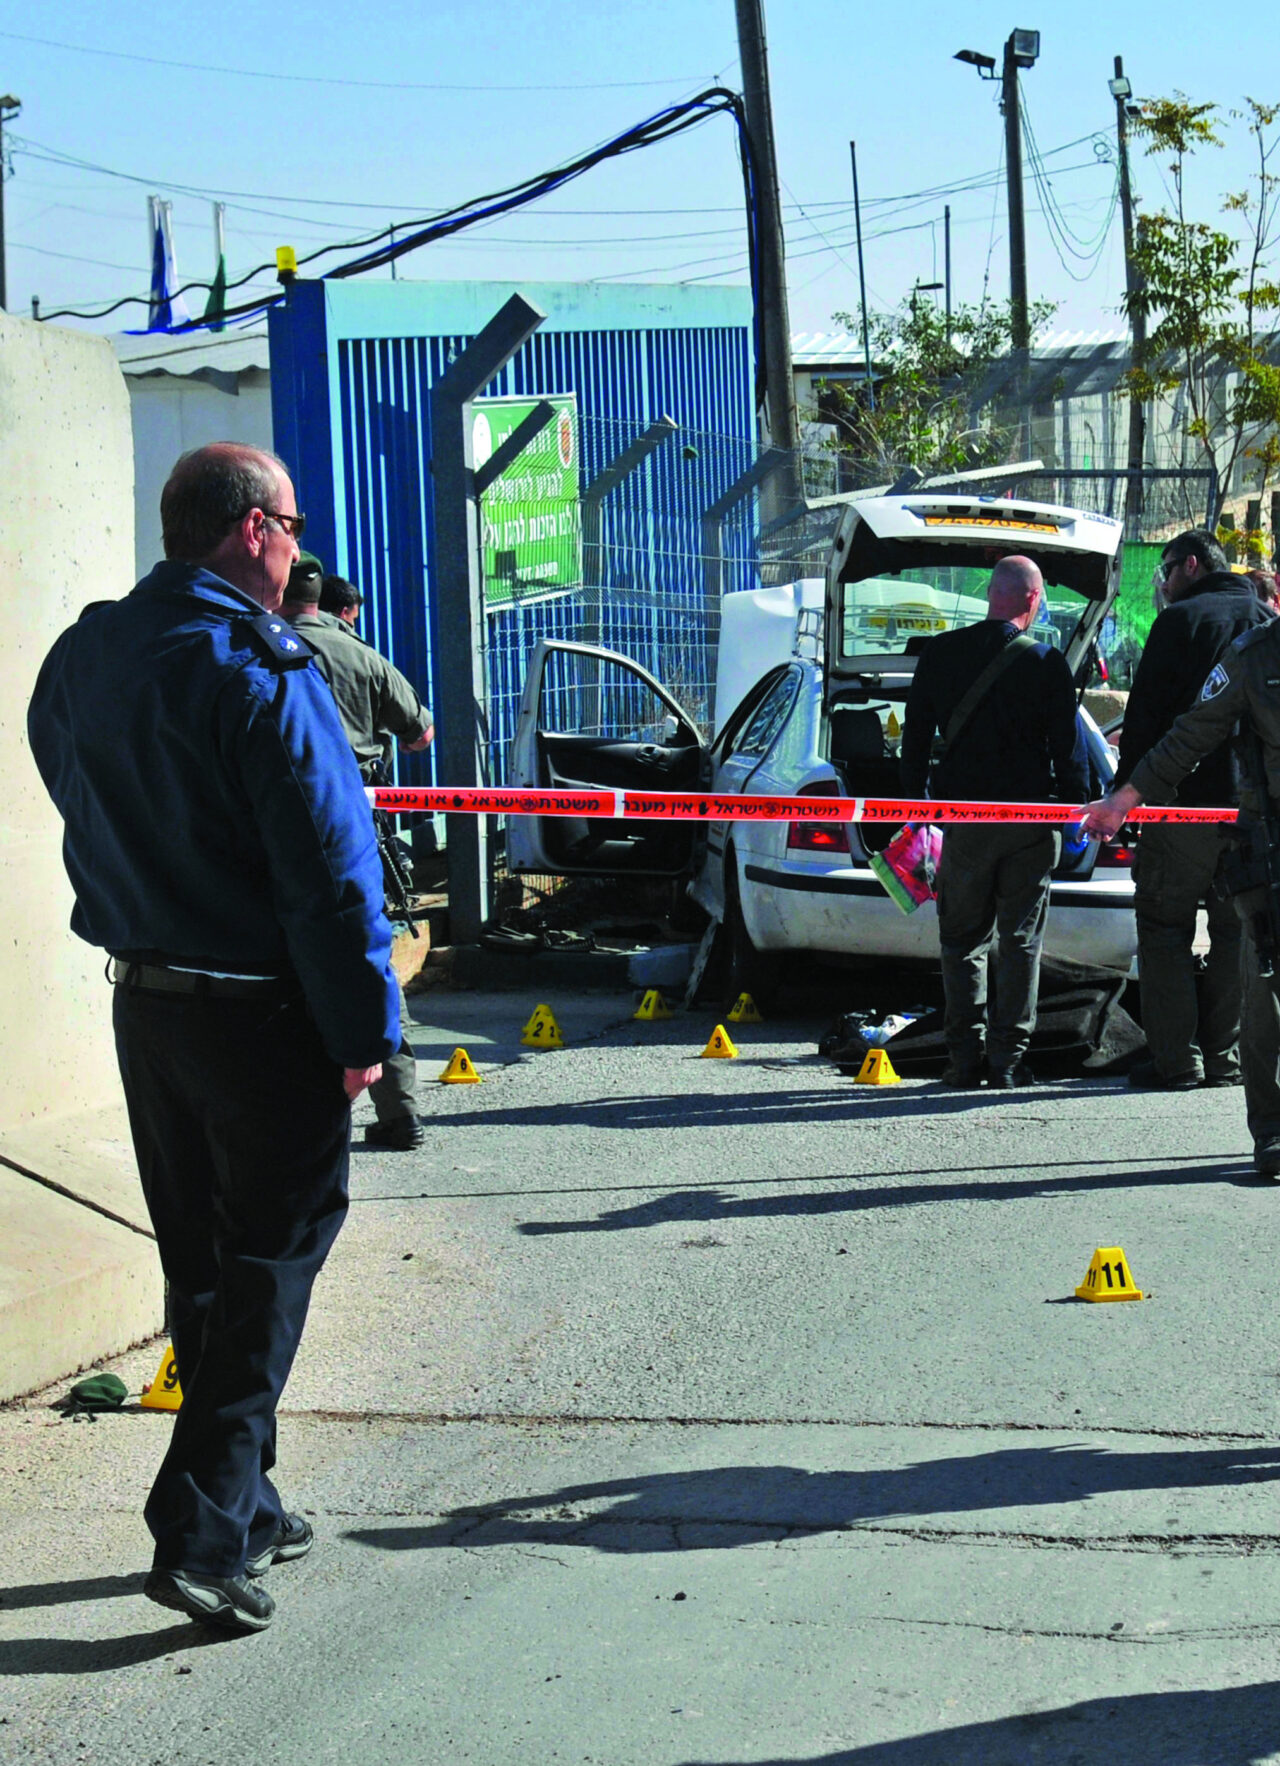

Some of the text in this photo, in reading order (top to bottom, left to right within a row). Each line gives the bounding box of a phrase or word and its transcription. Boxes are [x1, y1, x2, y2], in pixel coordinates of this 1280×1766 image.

[424, 794, 447, 807] אין
[468, 793, 519, 808] ישראל
[538, 797, 600, 811] משטרת
[621, 800, 840, 816] משטרת ישראל אין מעבר
[861, 807, 903, 818] מעבר
[907, 807, 930, 819] אין
[949, 807, 996, 819] ישראל
[533, 1021, 544, 1037] 2
[715, 1036, 722, 1049] 3
[460, 1058, 468, 1071] 6
[867, 1057, 877, 1075] 7
[1101, 1261, 1126, 1288] 11
[163, 1359, 178, 1390] 9
